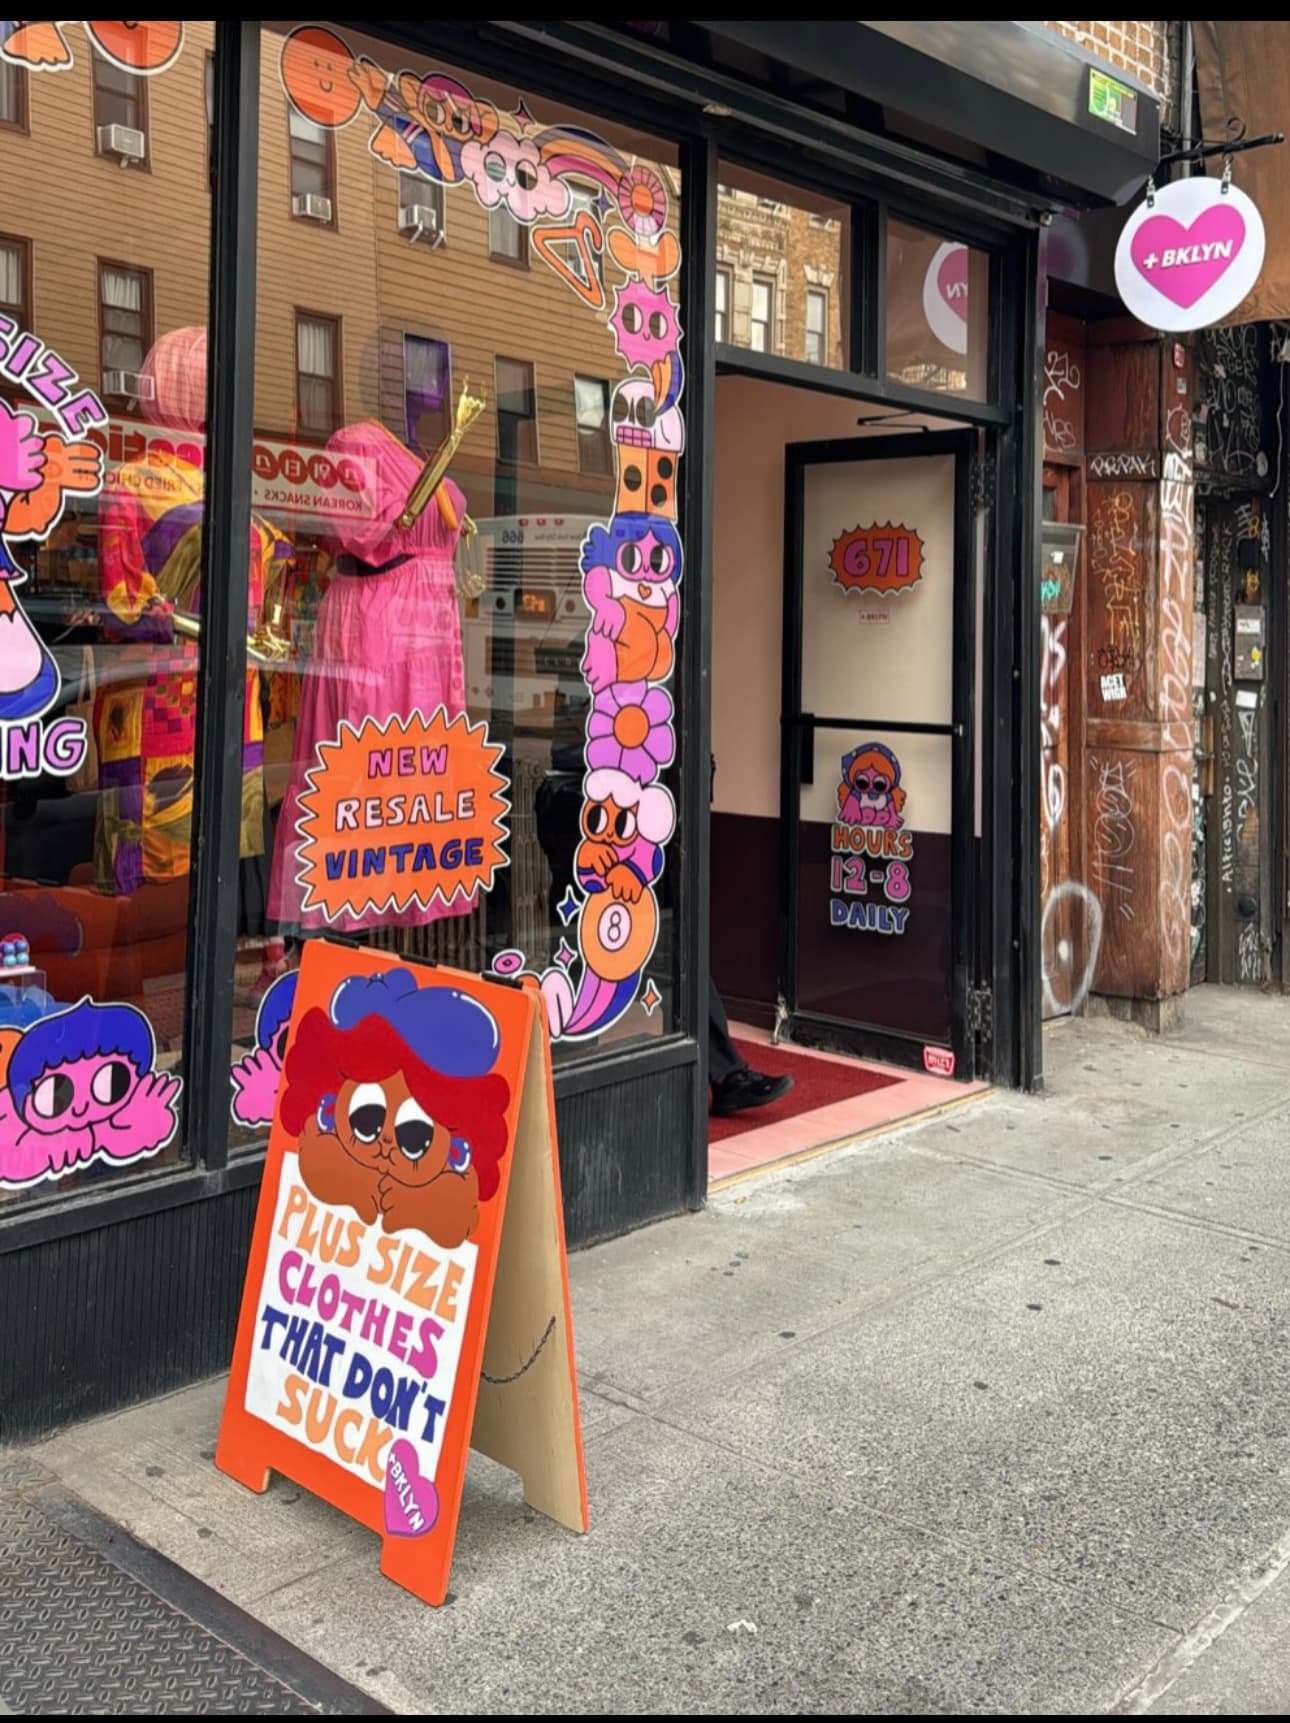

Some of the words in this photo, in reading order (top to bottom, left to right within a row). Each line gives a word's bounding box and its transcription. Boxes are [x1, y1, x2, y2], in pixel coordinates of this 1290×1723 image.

[1161, 239, 1233, 268] BKLYN
[843, 537, 909, 578] 671
[368, 744, 448, 779] NEW
[335, 789, 475, 832] RESALE
[325, 838, 484, 880] VINTAGE
[831, 826, 913, 858] HOURS
[832, 857, 910, 899] 12-8
[832, 900, 909, 933] DAILY
[277, 1185, 367, 1268] PLUS
[366, 1234, 466, 1324] SIZE
[278, 1250, 445, 1379] CLOTHES
[260, 1305, 346, 1387] THAT
[342, 1352, 446, 1443] DON'T
[276, 1374, 395, 1483] SUCK
